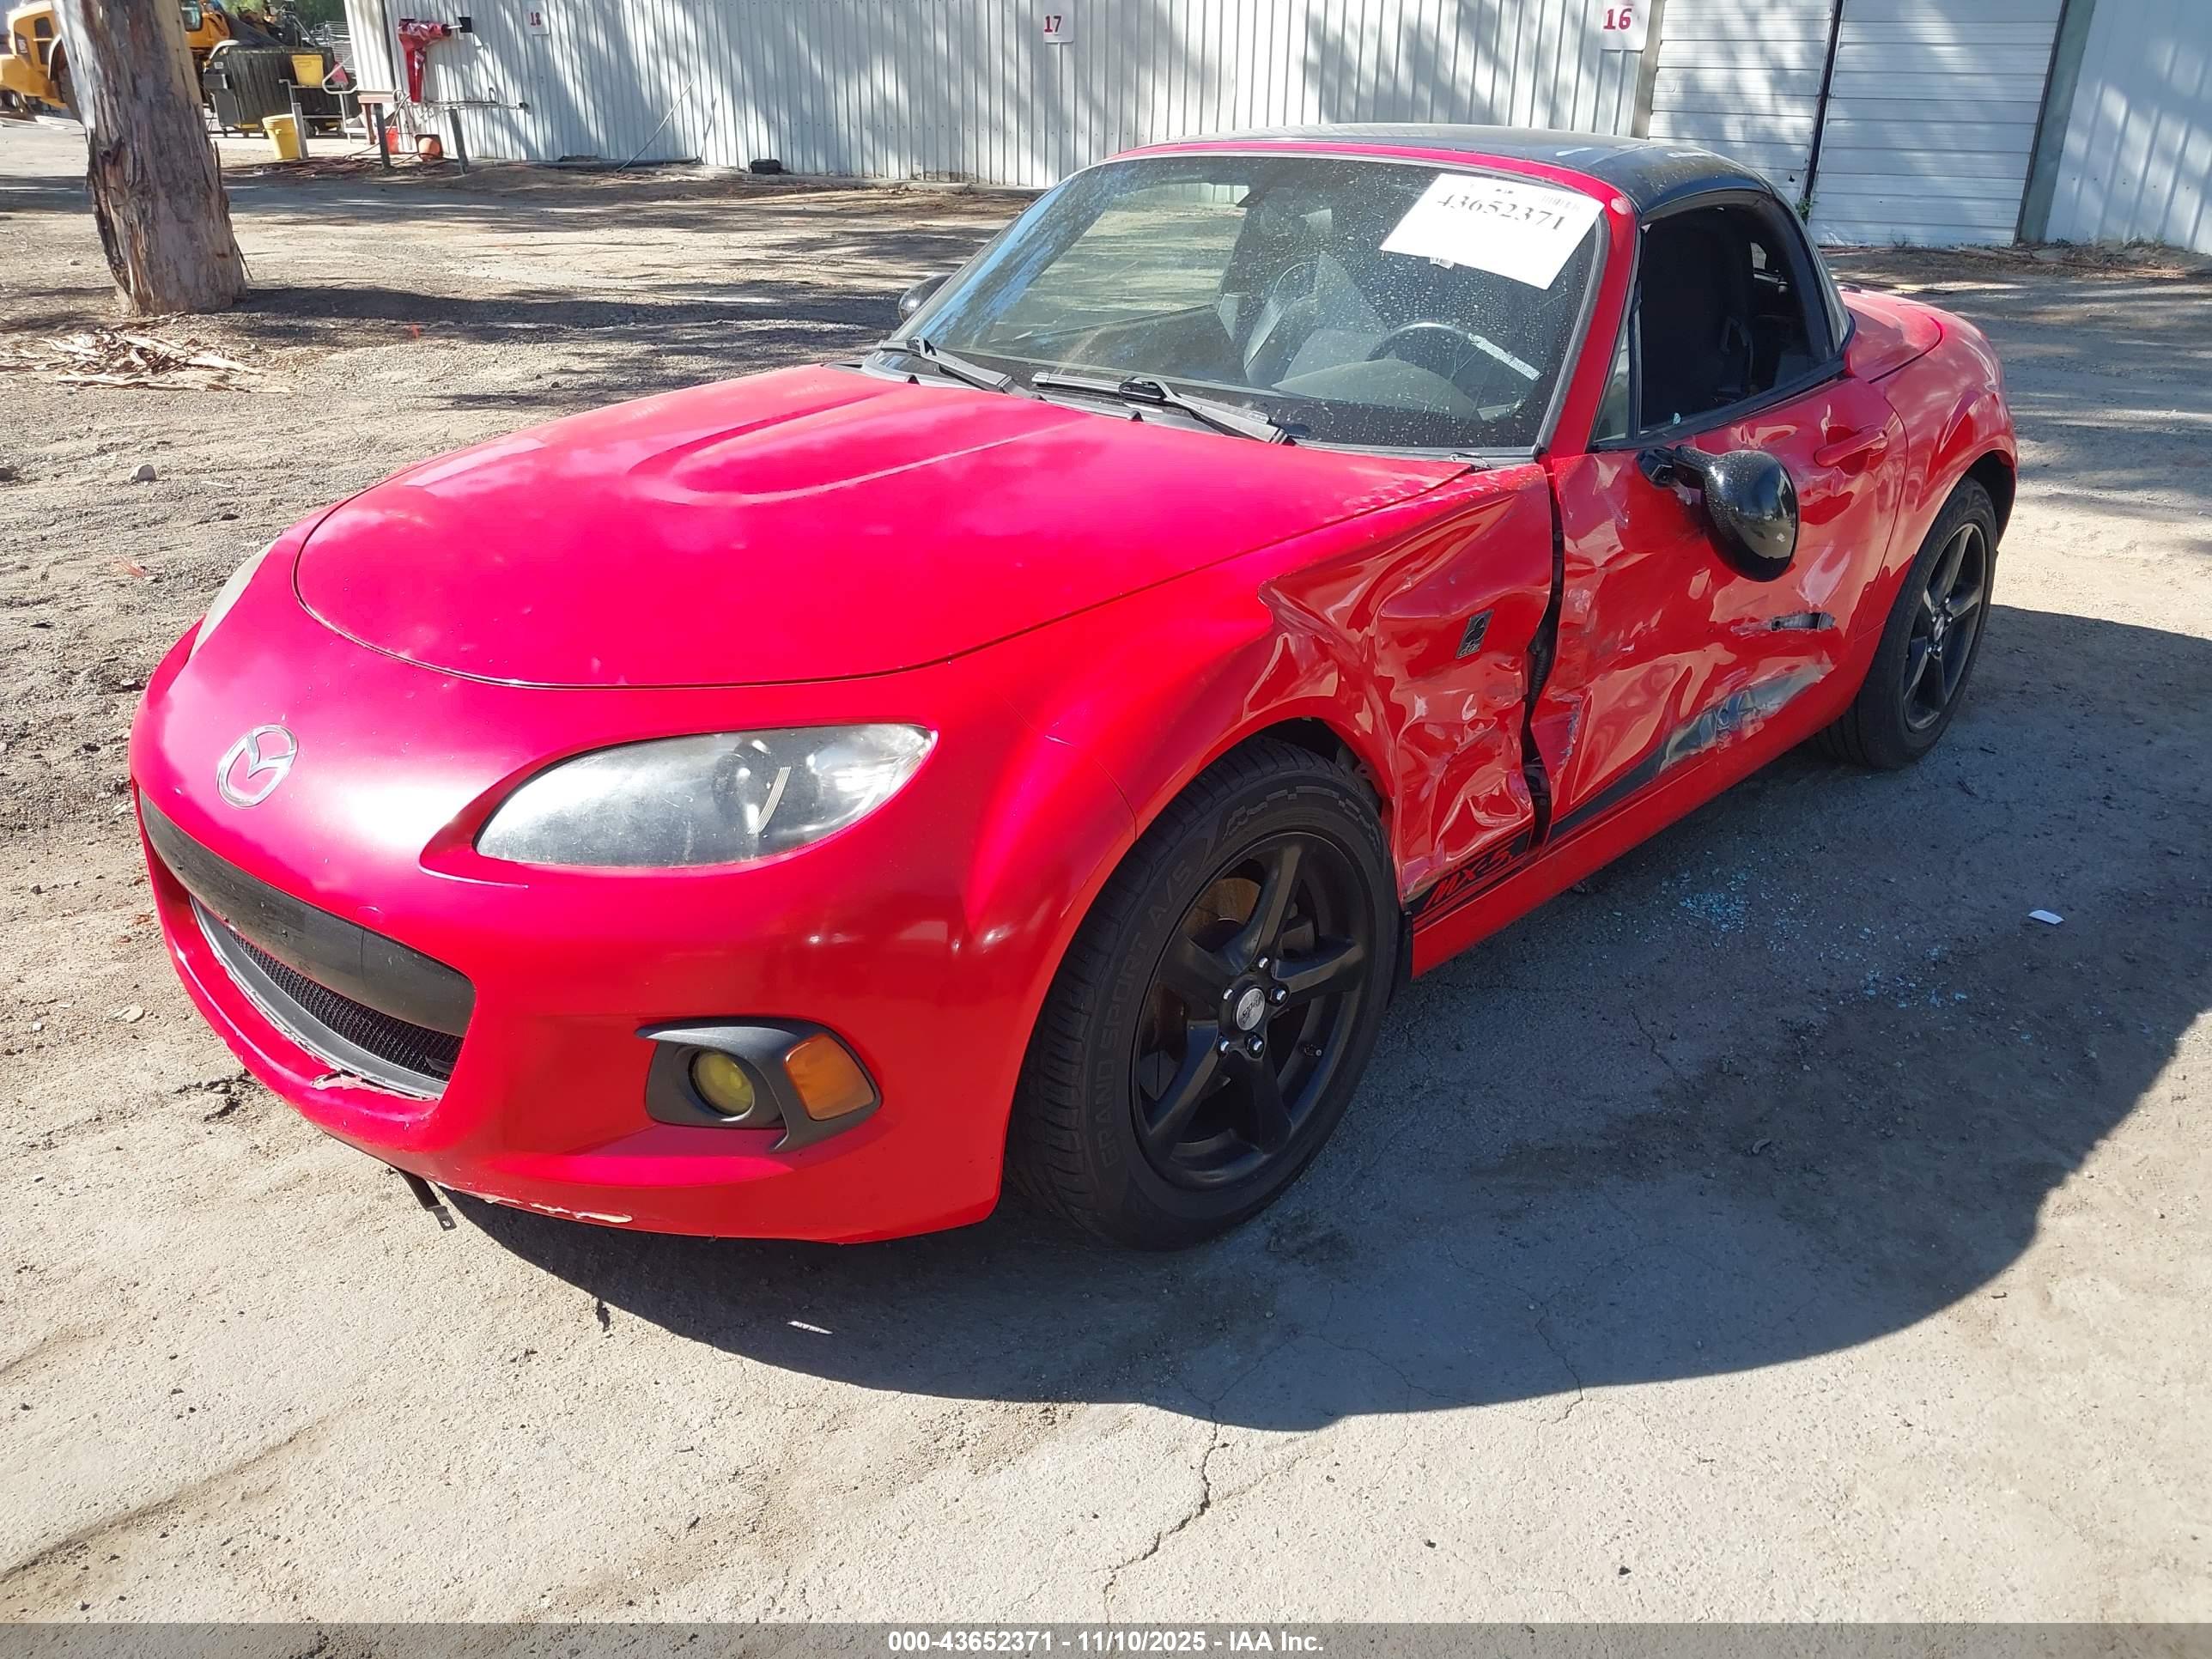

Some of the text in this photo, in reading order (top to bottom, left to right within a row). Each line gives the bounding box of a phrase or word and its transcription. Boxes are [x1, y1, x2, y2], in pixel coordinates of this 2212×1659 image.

[1044, 15, 1062, 33] 17
[1603, 8, 1632, 30] 16
[1437, 193, 1566, 231] 43652371
